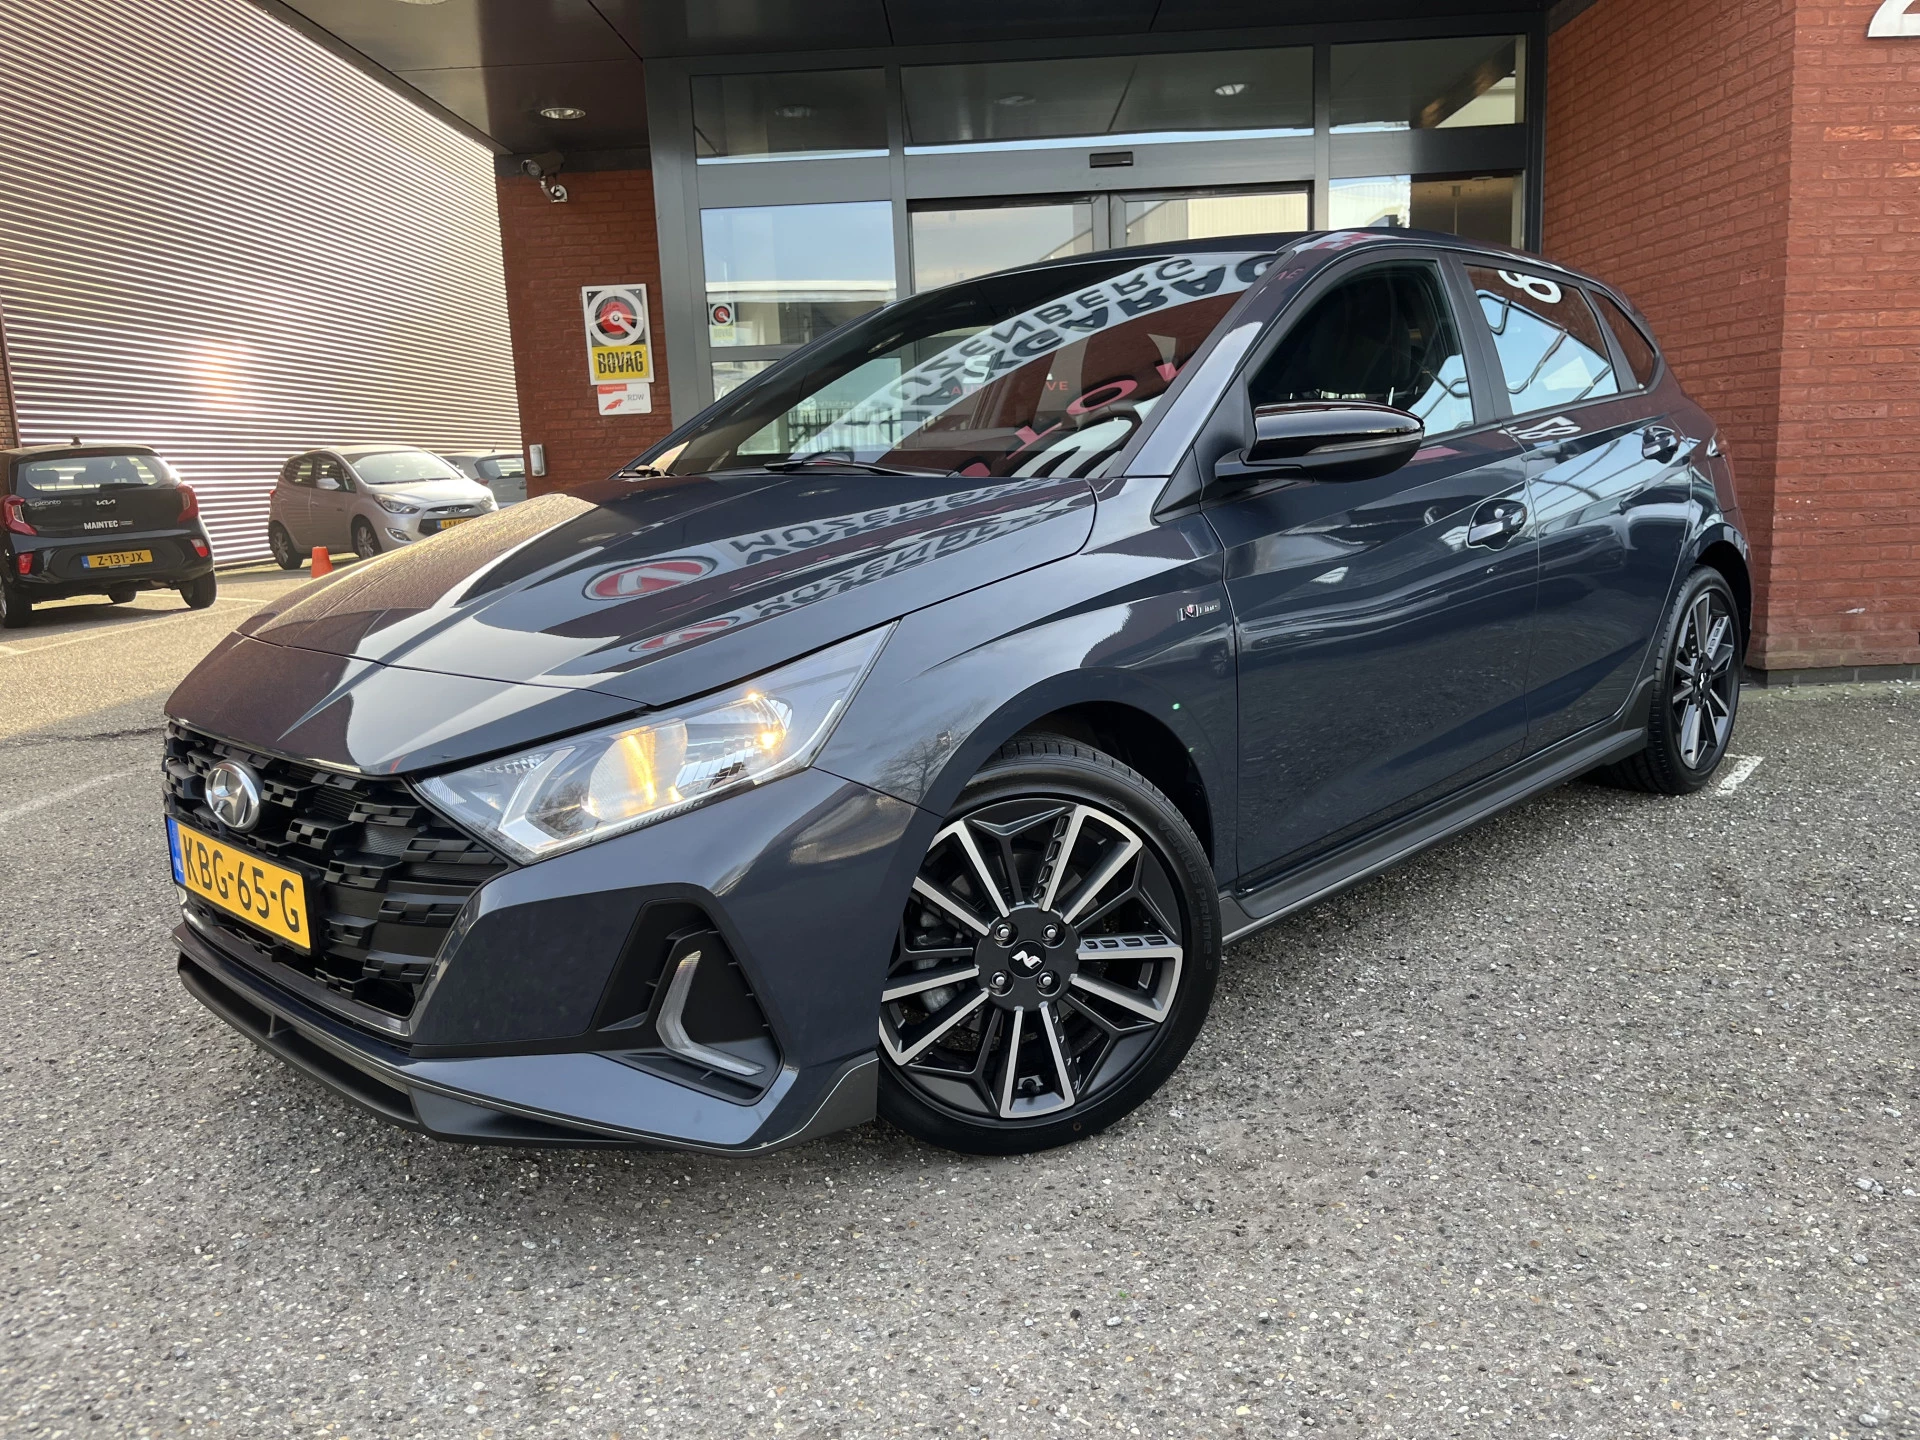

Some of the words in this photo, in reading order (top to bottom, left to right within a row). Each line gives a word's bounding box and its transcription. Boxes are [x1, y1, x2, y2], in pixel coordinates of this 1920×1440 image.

[597, 350, 644, 374] BOVAG
[83, 520, 119, 530] MAINTEC
[97, 552, 144, 566] Z-131-JX
[182, 833, 300, 933] KBG-65-G
